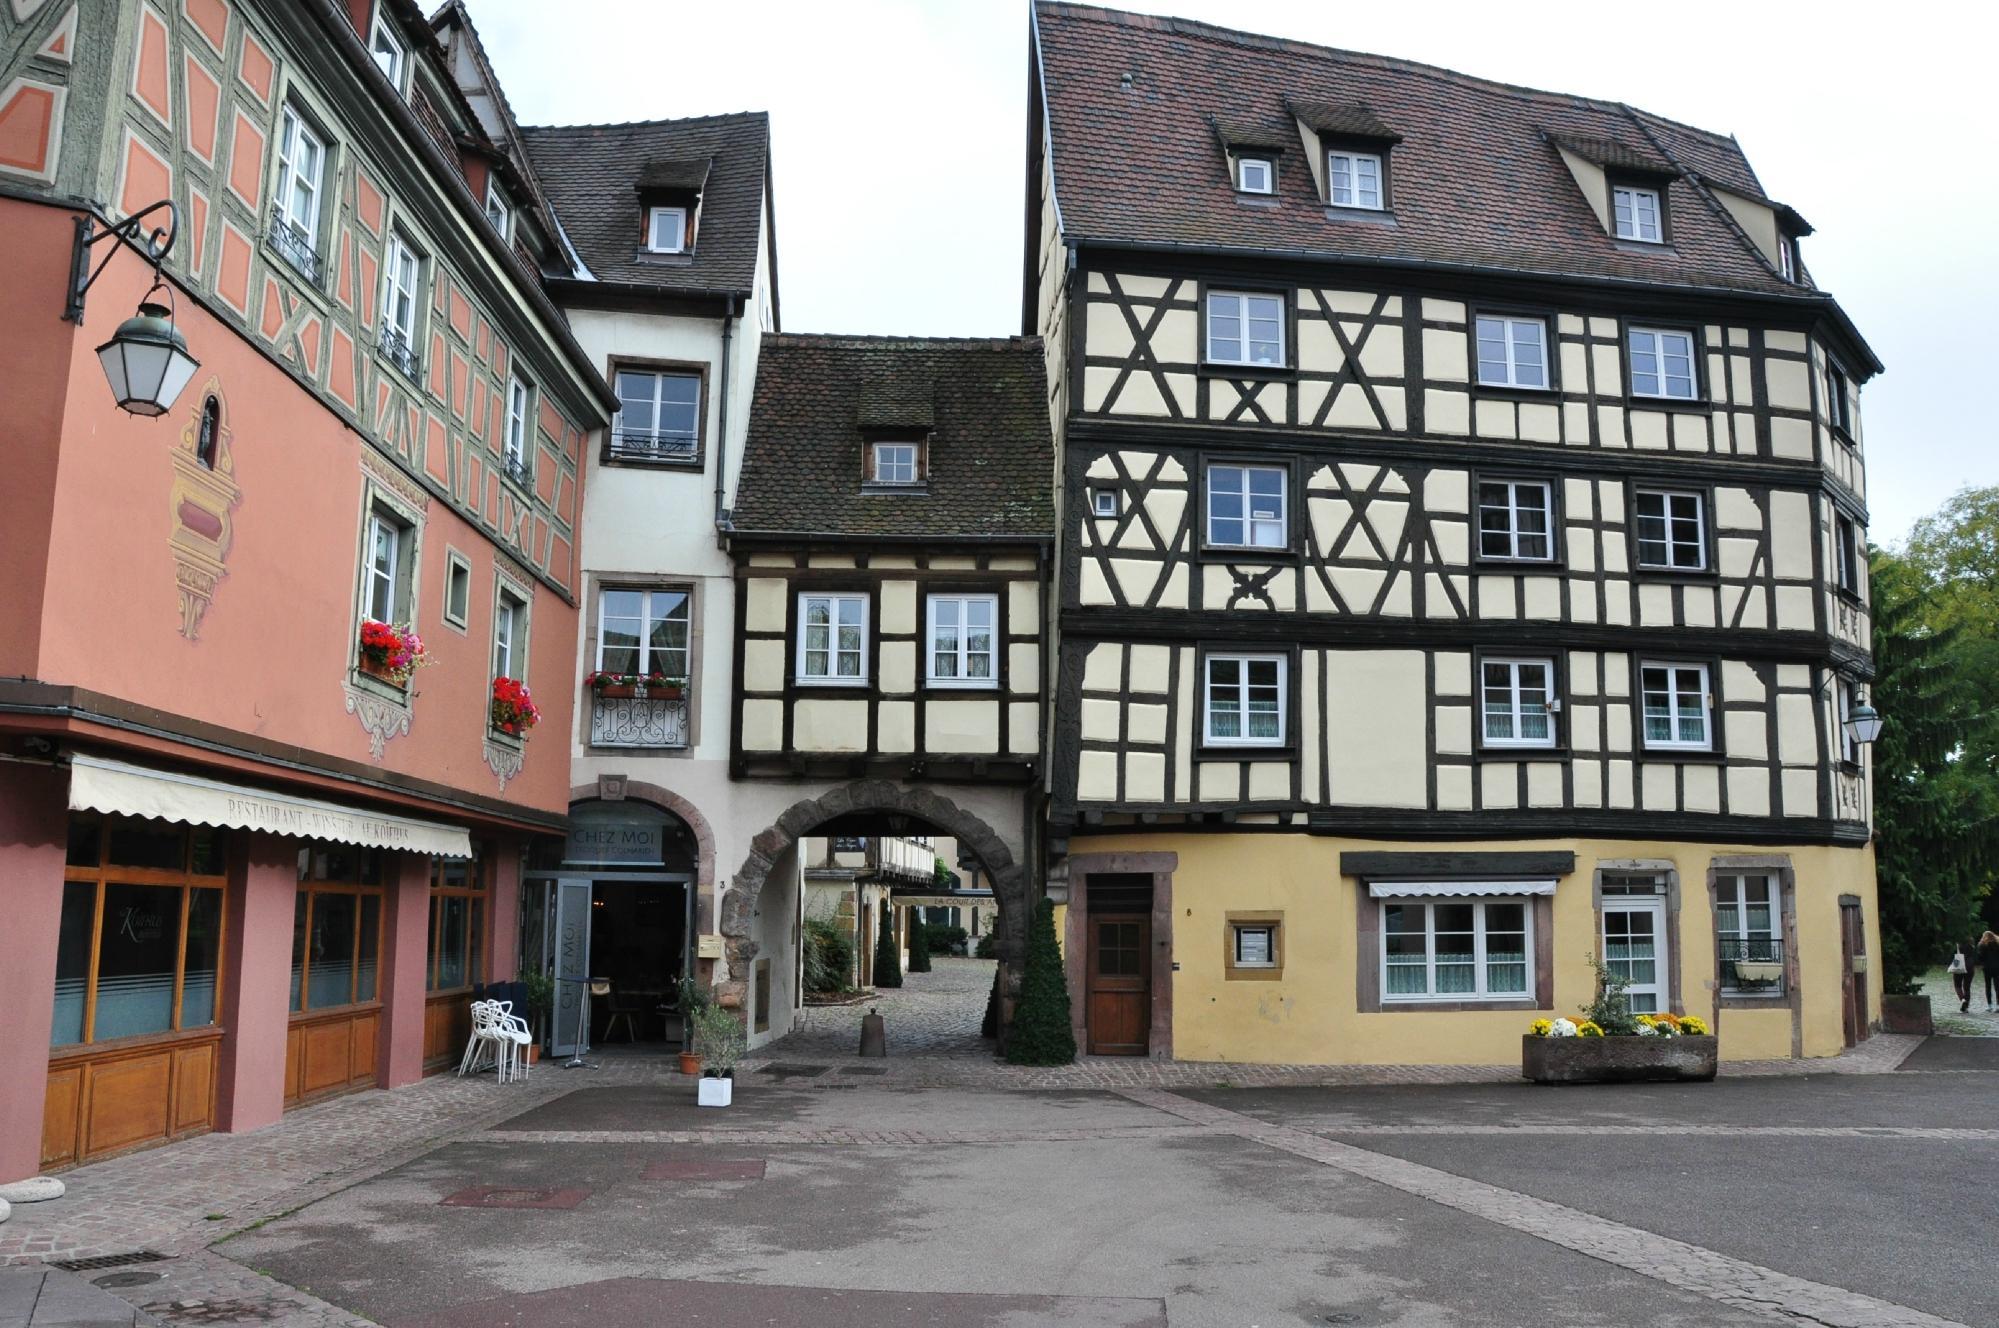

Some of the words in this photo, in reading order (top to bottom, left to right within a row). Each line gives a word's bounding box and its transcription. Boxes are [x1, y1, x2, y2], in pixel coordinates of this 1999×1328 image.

[228, 799, 302, 828] RESTAURANT
[573, 829, 615, 843] CHEZ
[621, 831, 654, 844] MOI
[720, 880, 725, 889] 3
[561, 965, 573, 1009] CHZ
